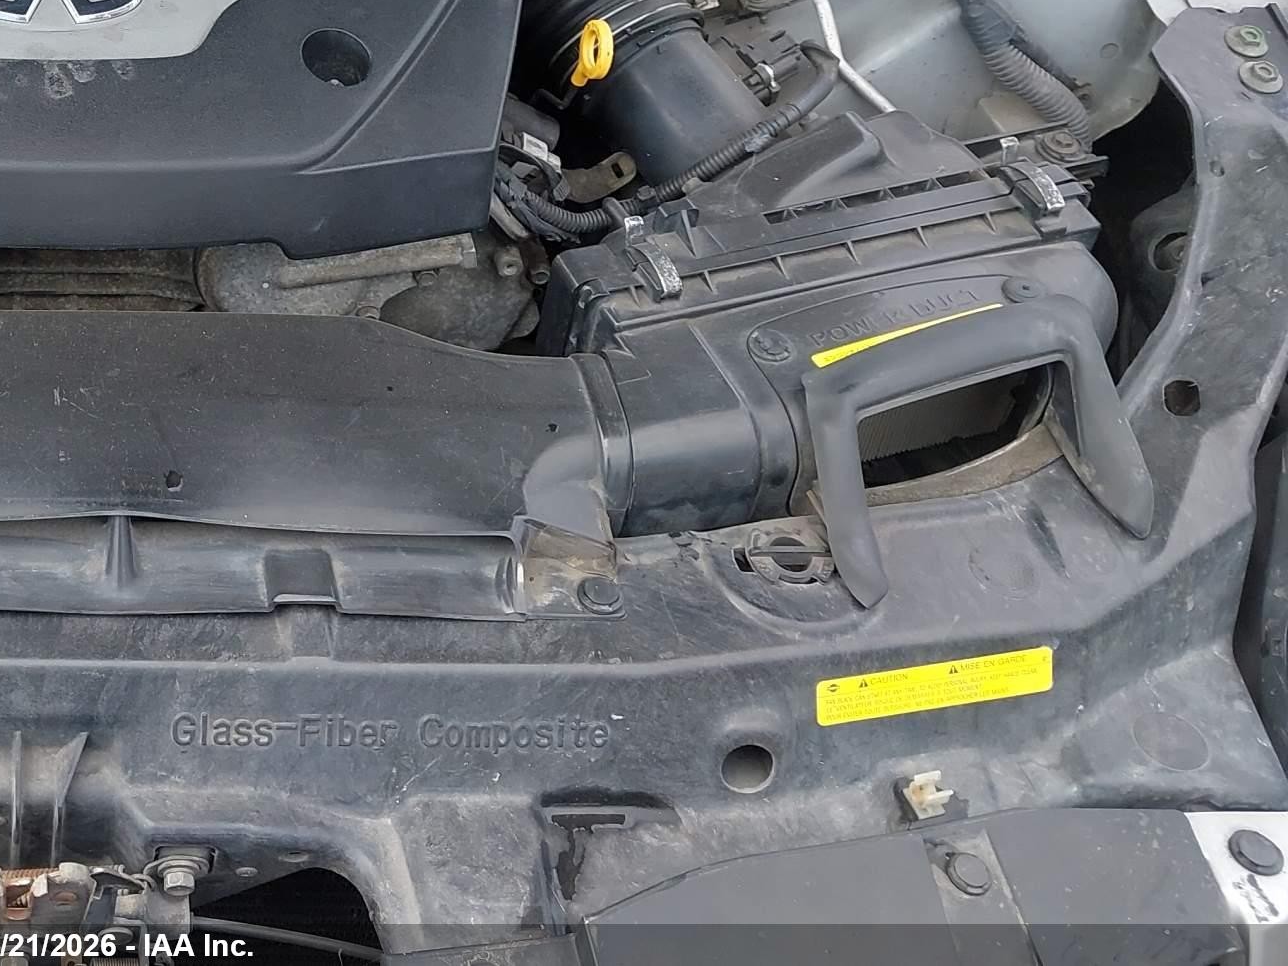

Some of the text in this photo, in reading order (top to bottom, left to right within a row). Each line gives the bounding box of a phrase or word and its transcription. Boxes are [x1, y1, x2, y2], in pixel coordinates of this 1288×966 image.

[960, 654, 1027, 671] MISE EN GARDE
[870, 673, 908, 685] CAUTION
[170, 712, 610, 753] Glass-Fiber Composite
